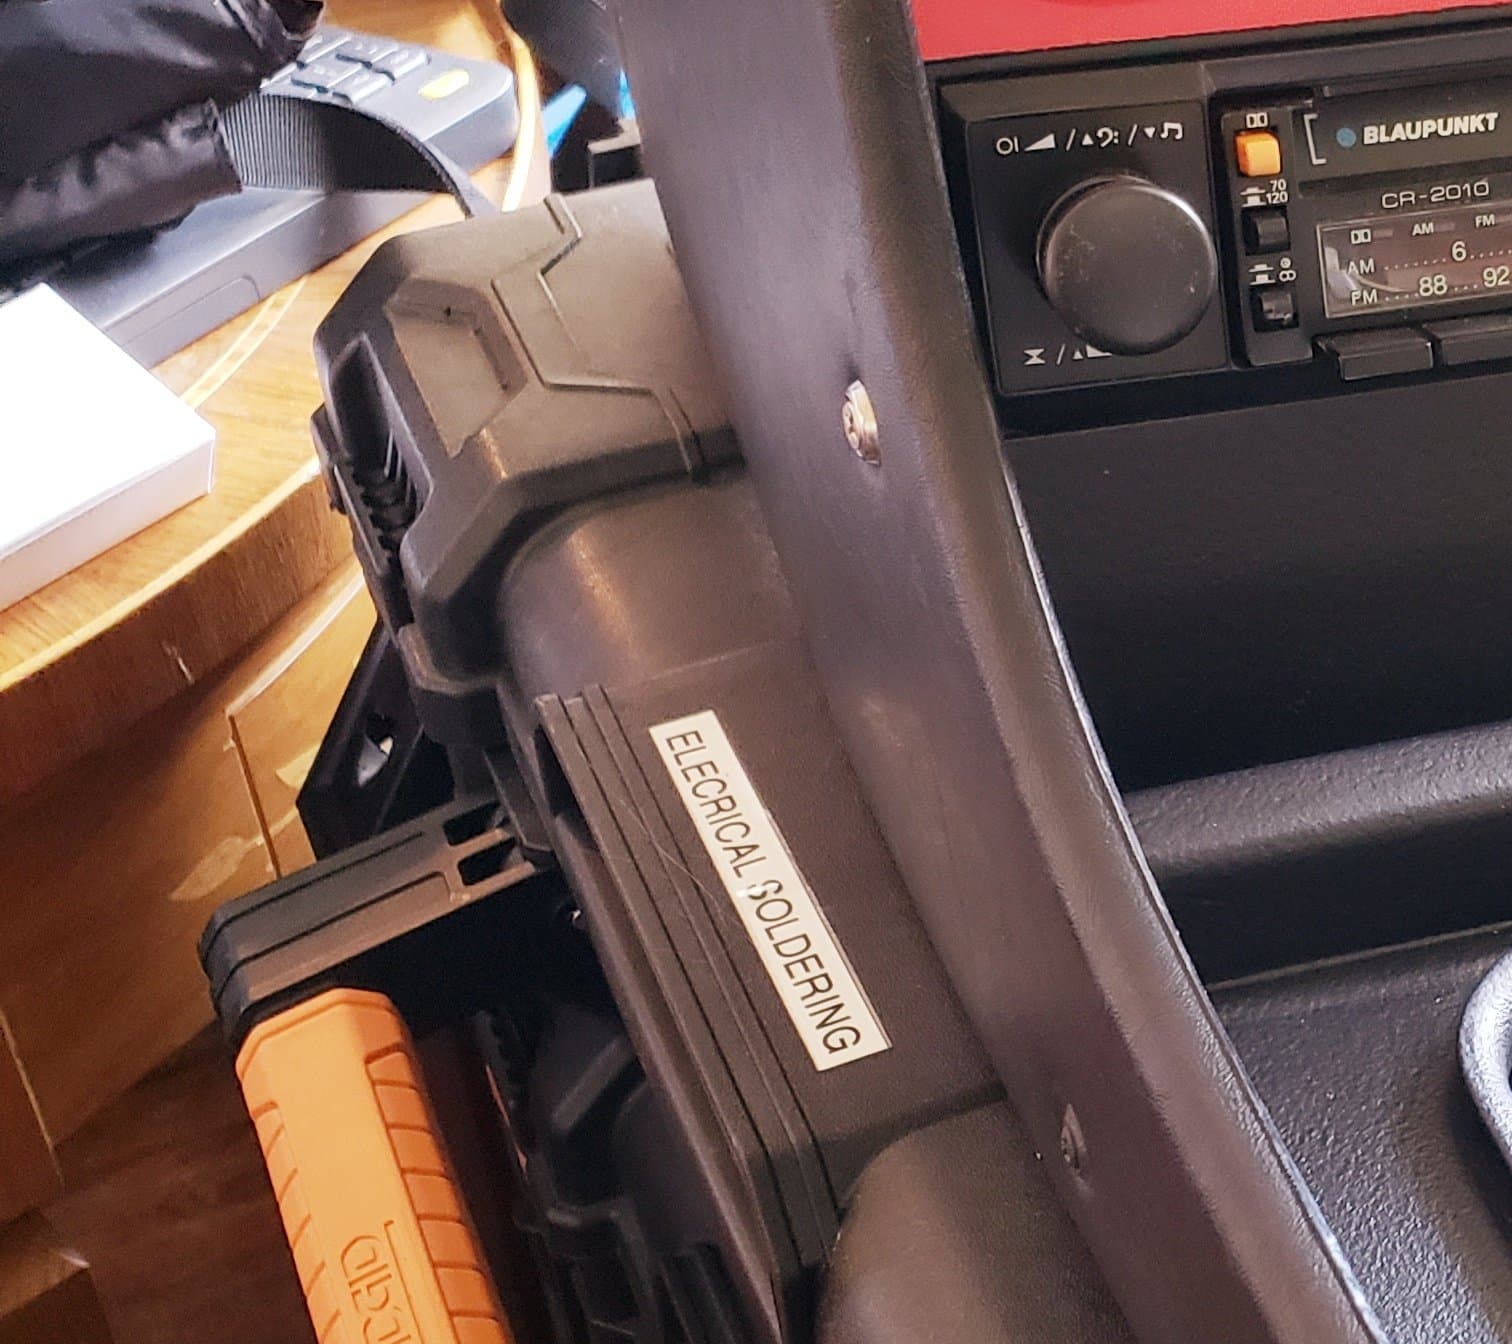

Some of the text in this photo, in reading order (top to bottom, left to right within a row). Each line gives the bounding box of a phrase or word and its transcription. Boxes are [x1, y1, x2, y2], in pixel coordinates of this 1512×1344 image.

[1362, 111, 1499, 146] BLAUPUNKT
[1265, 191, 1289, 205] 120
[1269, 178, 1287, 192] 70
[1381, 181, 1490, 209] CR-2010
[1411, 213, 1496, 237] AM FM
[1347, 258, 1375, 275] AM
[1451, 240, 1468, 262] 6
[1351, 288, 1378, 306] FM
[1419, 274, 1448, 297] 88
[1483, 265, 1510, 287] 92
[665, 729, 861, 1054] ELECRICAL SOLDERING
